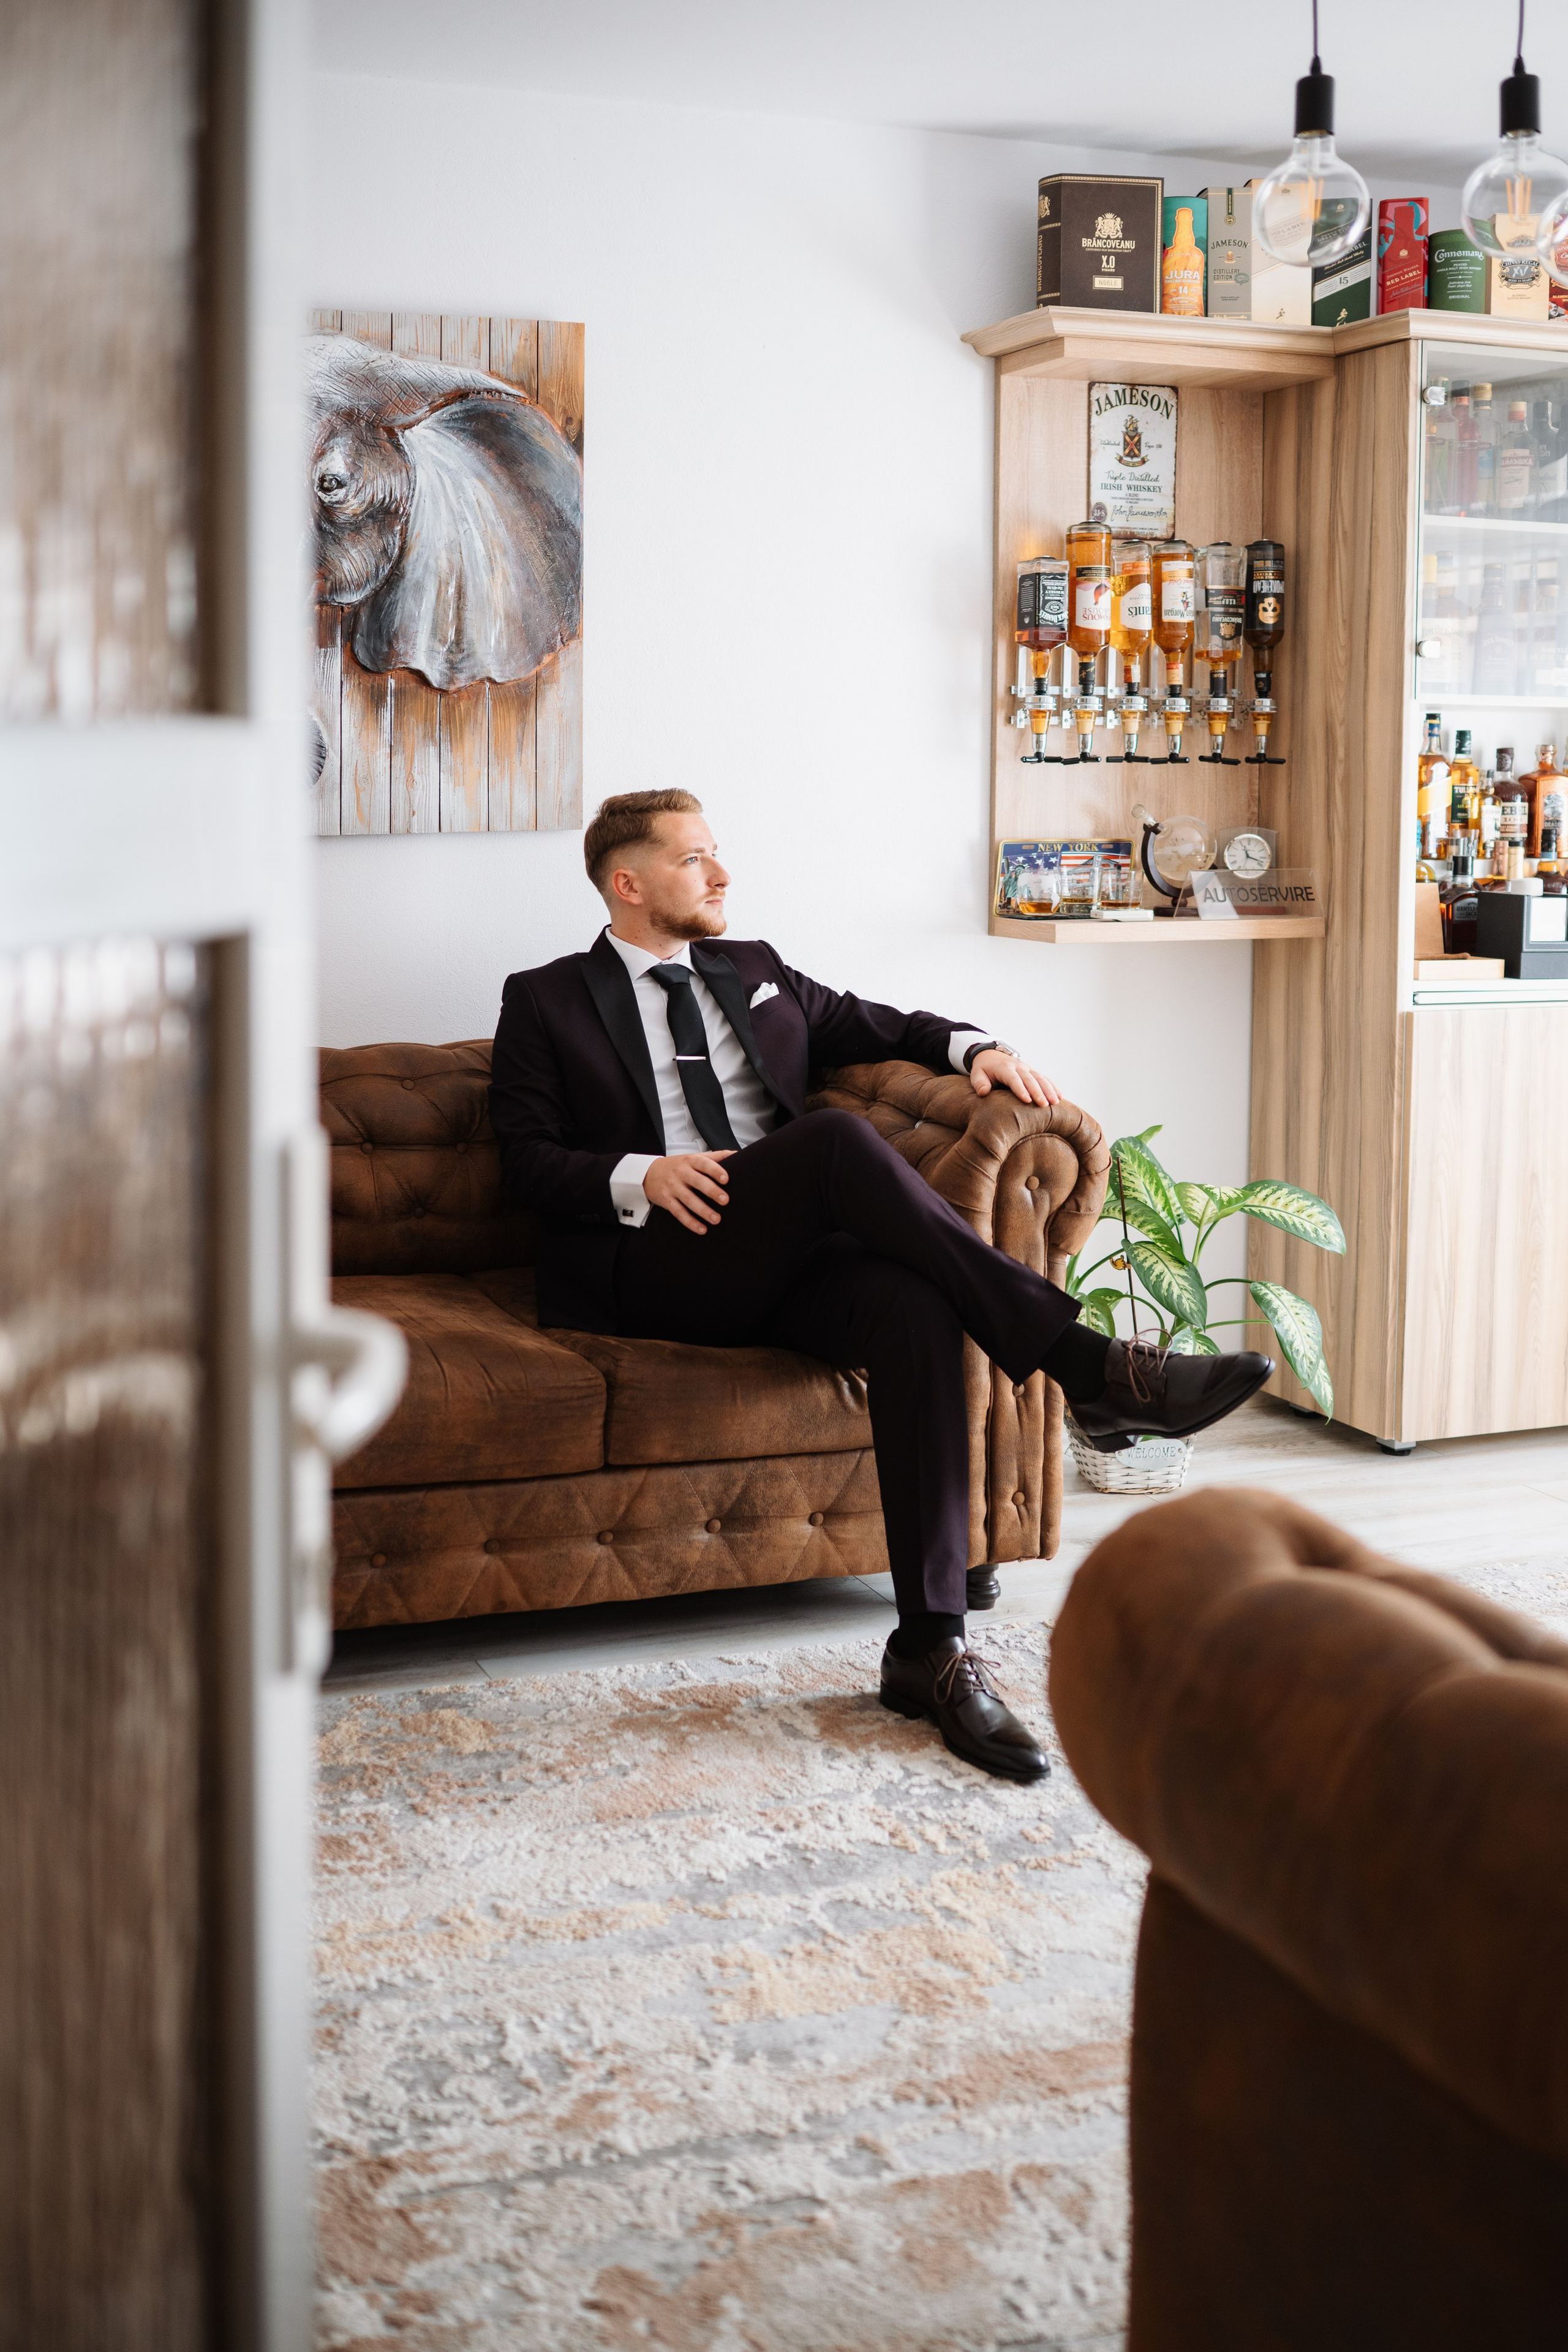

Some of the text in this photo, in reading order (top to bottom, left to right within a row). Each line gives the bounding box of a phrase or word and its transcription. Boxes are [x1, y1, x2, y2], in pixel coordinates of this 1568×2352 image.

[1082, 237, 1136, 249] BRÂNCOVEANU
[1211, 239, 1248, 250] JAMESON
[1102, 255, 1115, 269] X.O
[1165, 270, 1200, 280] JURA
[1400, 270, 1421, 281] LABEL
[1512, 265, 1529, 277] XV
[1178, 285, 1188, 295] 14
[1095, 388, 1175, 420] JAMESON
[1105, 470, 1160, 483] Triple Distilled
[1164, 608, 1185, 618] Morgan
[1038, 843, 1099, 852] NEW YORK
[1204, 886, 1315, 903] AUTOSERVIRE
[1127, 1446, 1176, 1458] WELCOME
